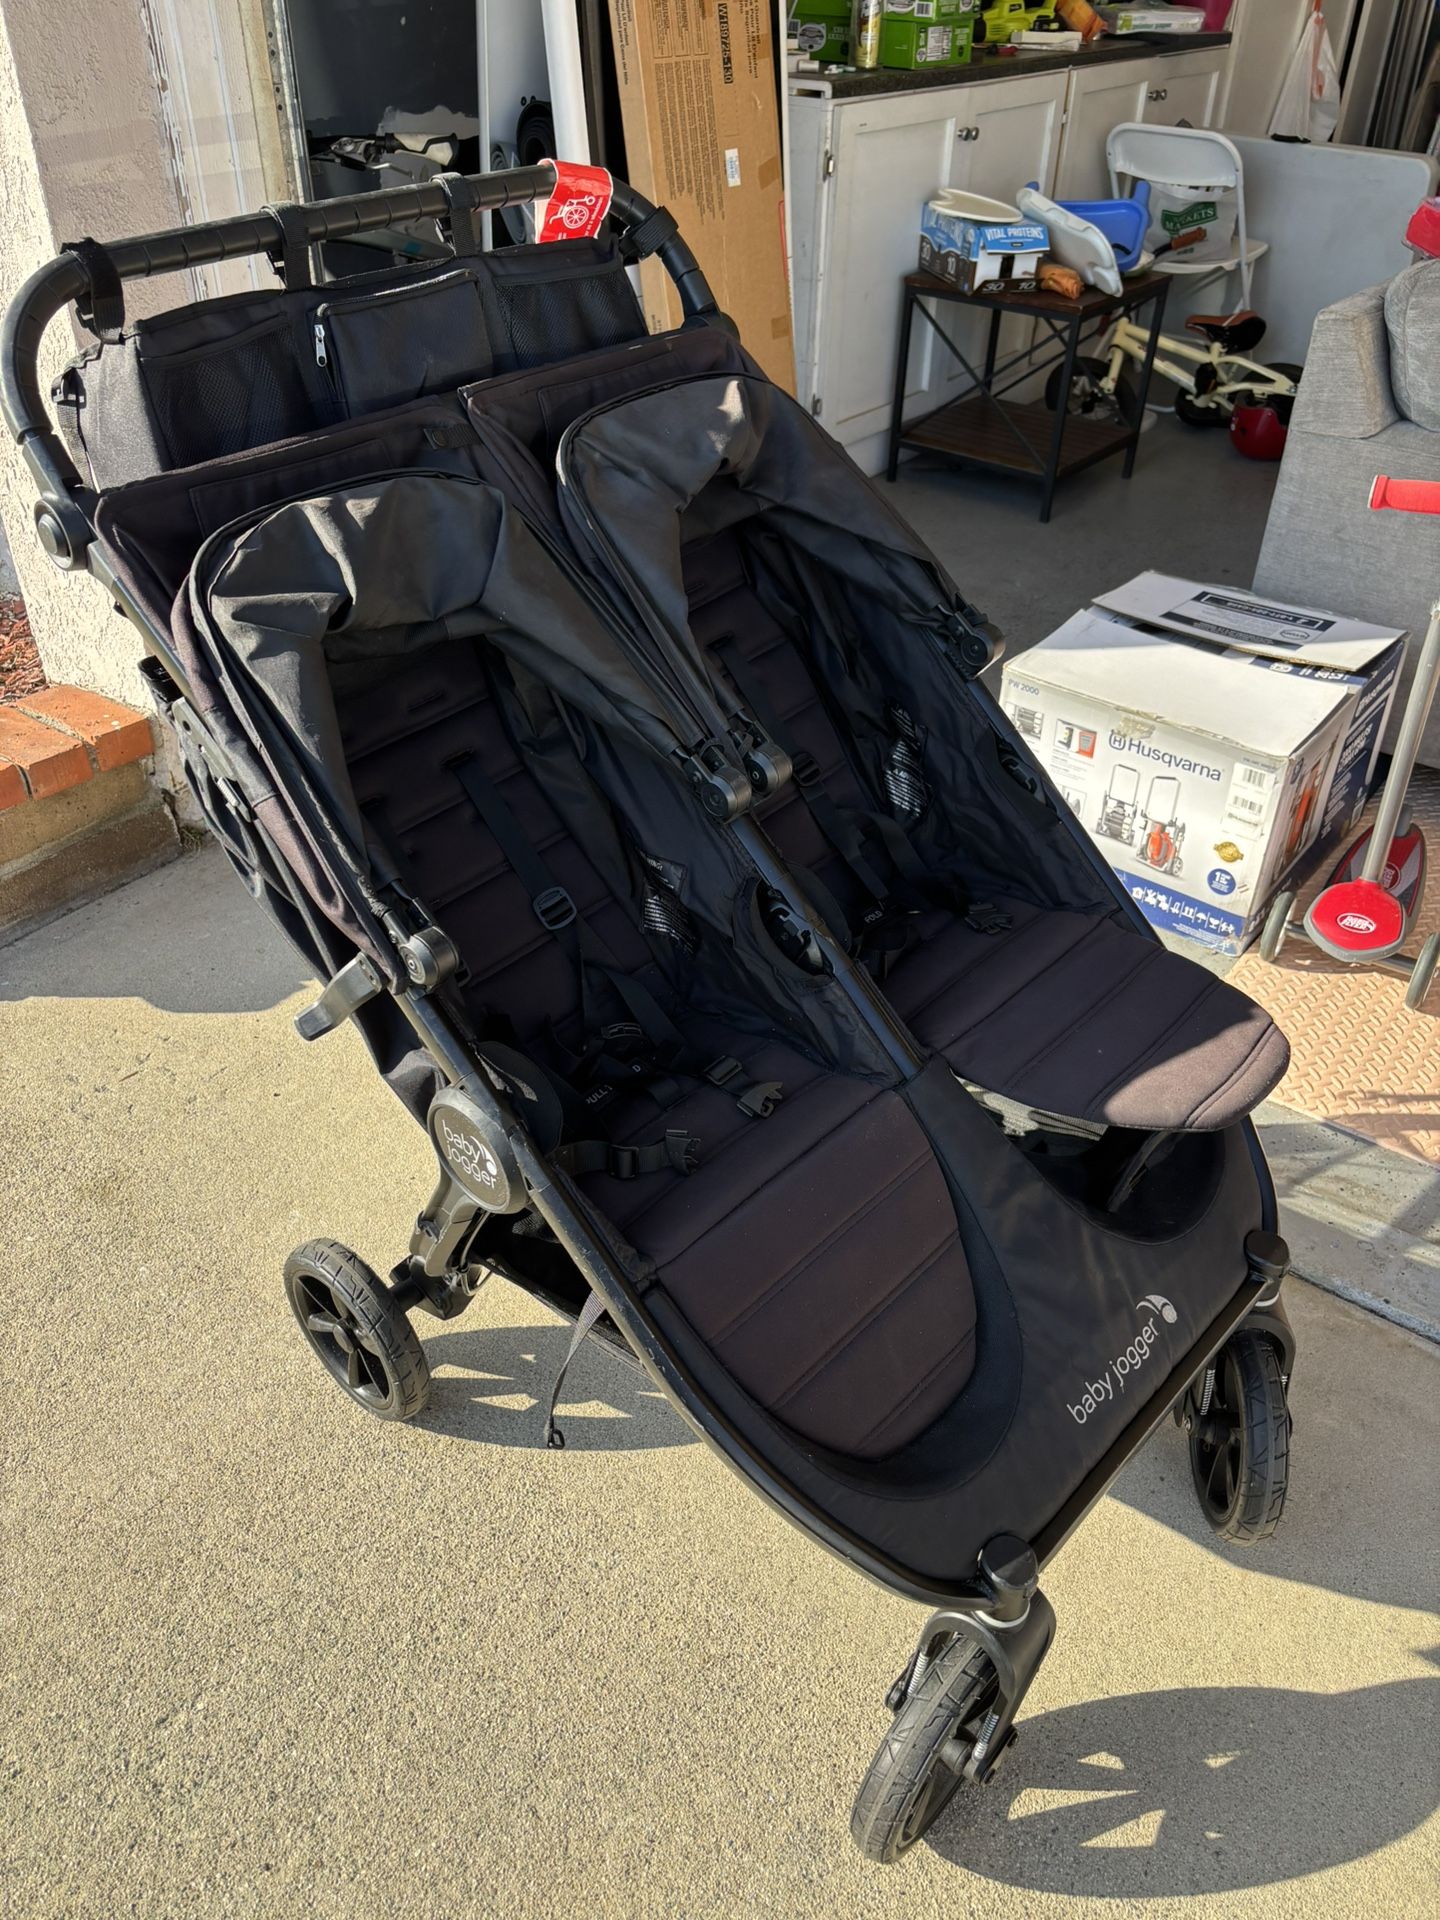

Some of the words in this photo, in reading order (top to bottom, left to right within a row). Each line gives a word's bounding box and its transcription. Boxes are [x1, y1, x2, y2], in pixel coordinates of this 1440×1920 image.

[717, 3, 734, 84] W189725-130
[984, 228, 1008, 241] VITAL
[1008, 226, 1045, 240] PROTEINS
[982, 281, 1005, 292] 30
[1018, 281, 1037, 291] 10
[1020, 682, 1040, 696] 2000
[1127, 737, 1222, 782] Husqvarna
[864, 910, 883, 924] FOLD
[441, 1119, 481, 1164] baby
[446, 1139, 497, 1190] jogger
[1066, 1371, 1114, 1425] baby
[1108, 1317, 1159, 1388] jogger
